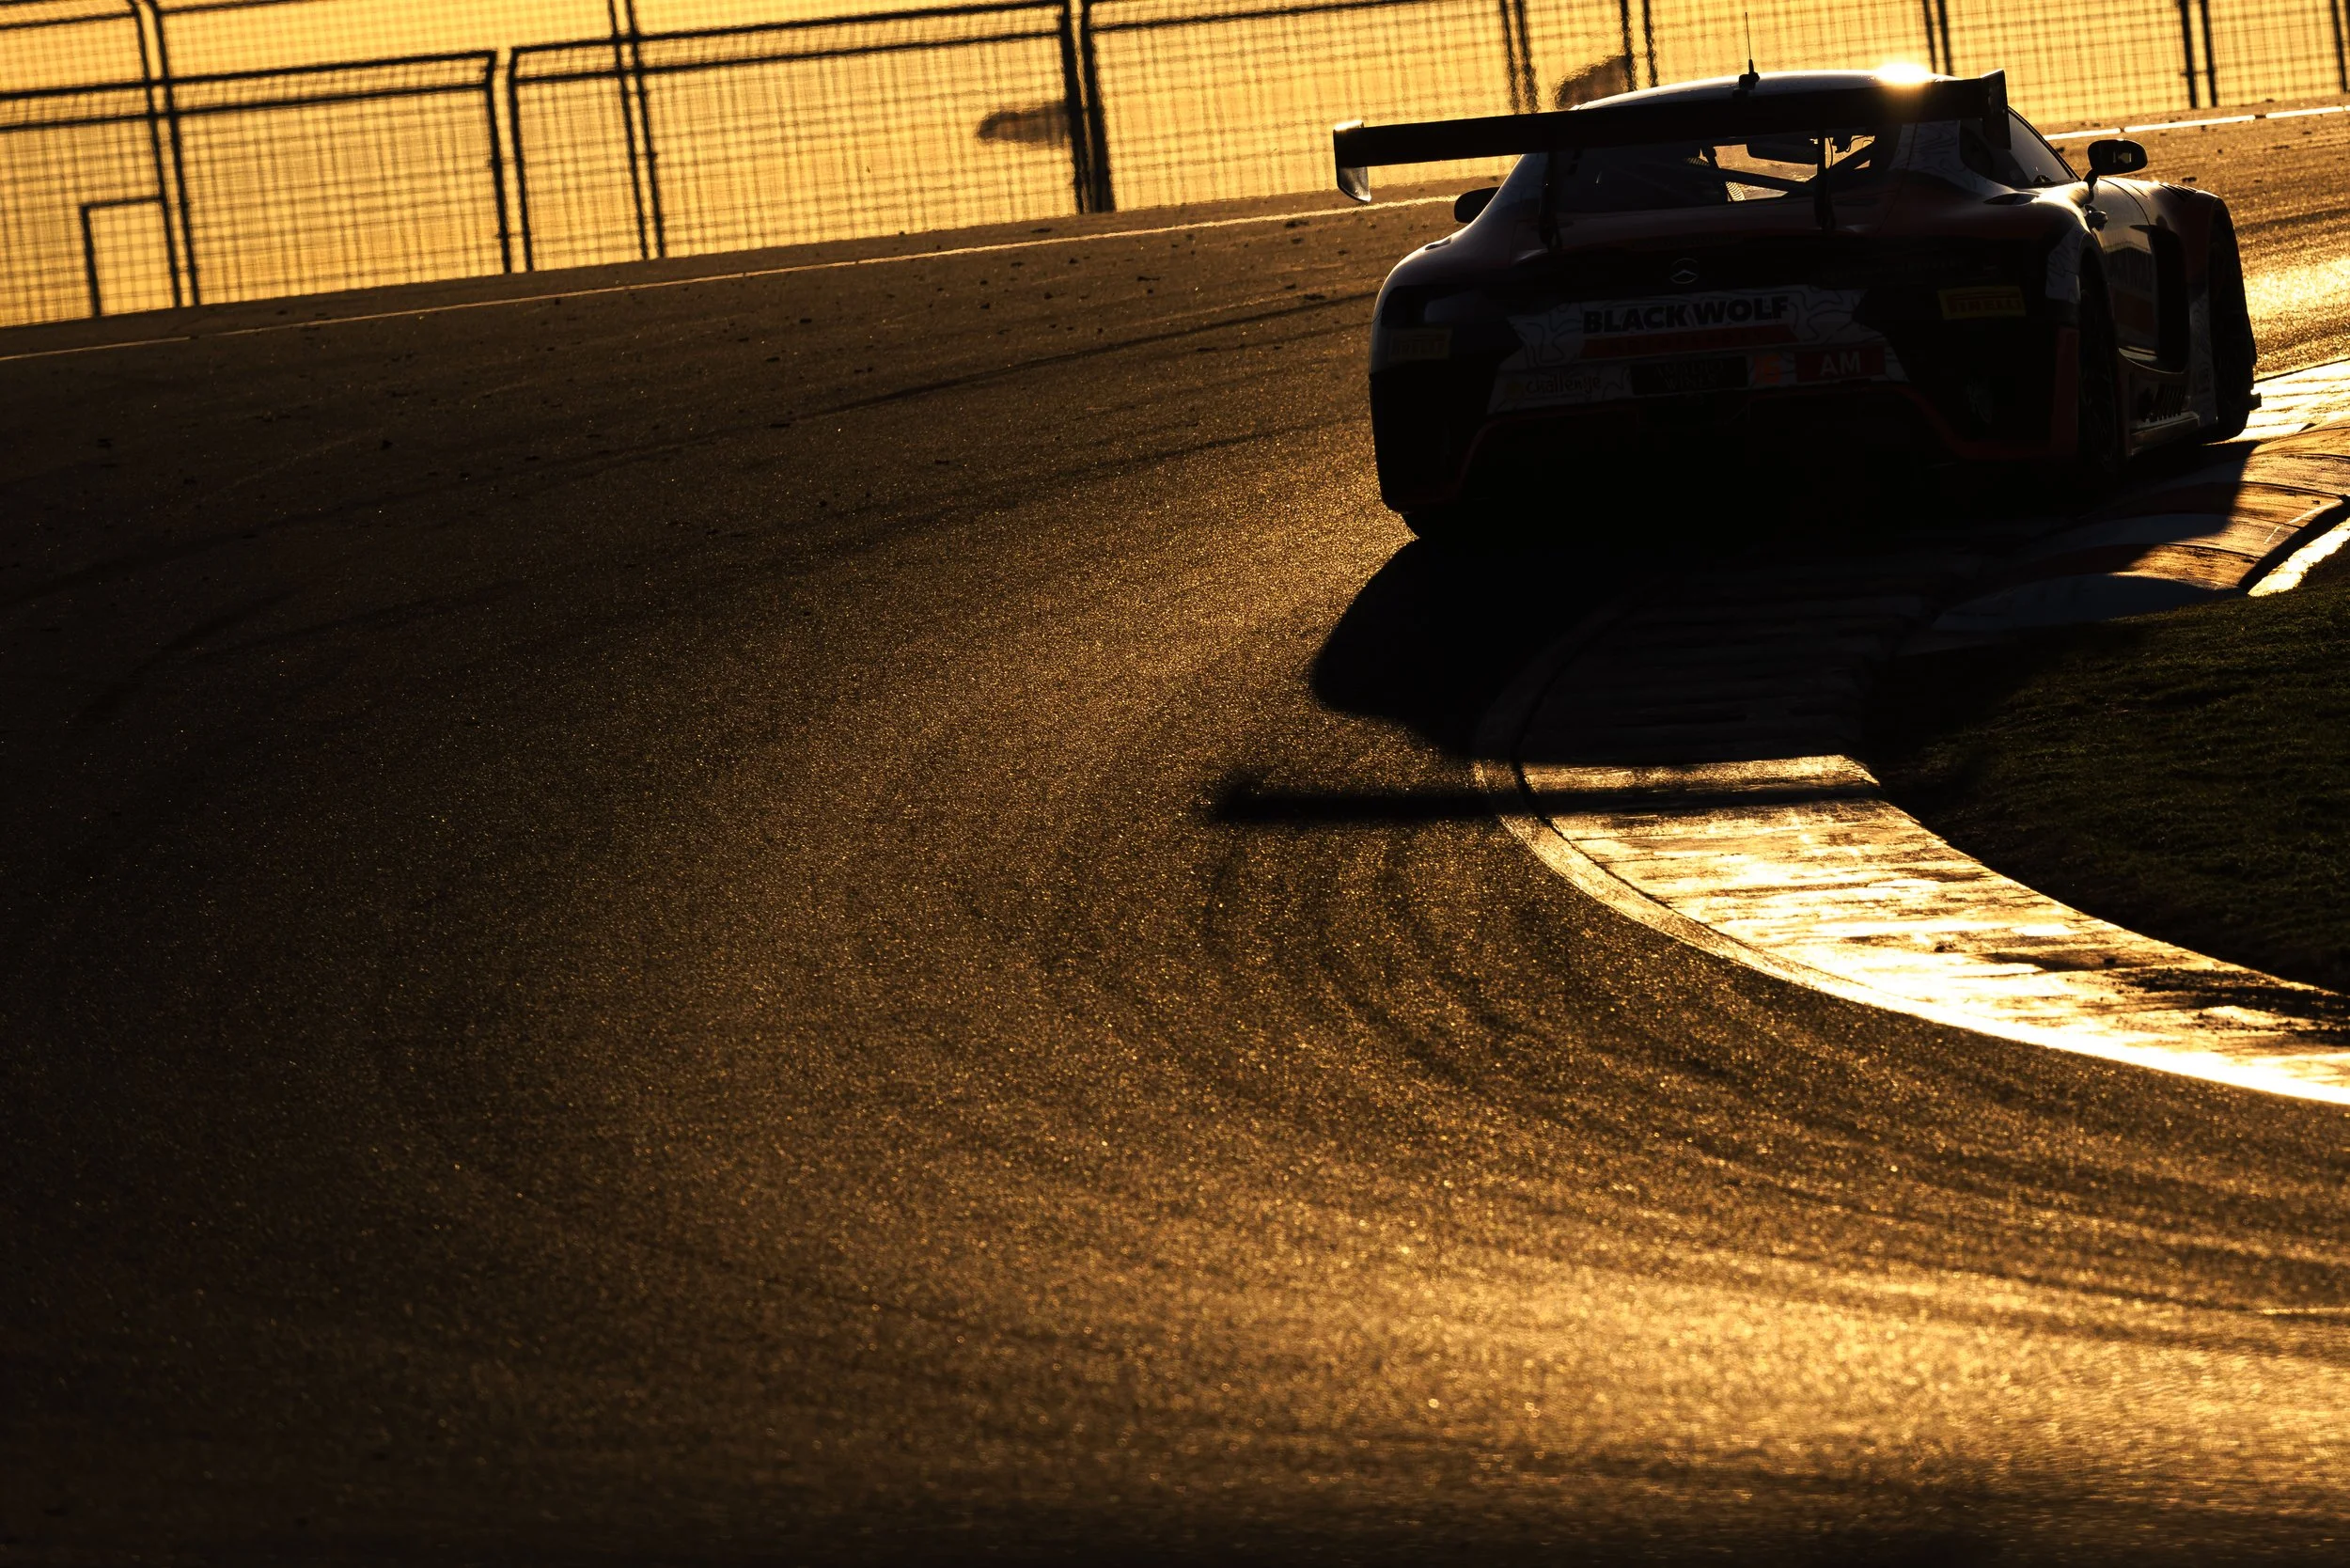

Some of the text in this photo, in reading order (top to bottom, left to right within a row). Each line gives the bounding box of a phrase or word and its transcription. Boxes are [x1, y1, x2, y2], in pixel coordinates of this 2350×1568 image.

[1583, 295, 1789, 335] BLACK WOLF
[1947, 291, 2022, 314] PIRELLI
[1820, 351, 1861, 377] AM
